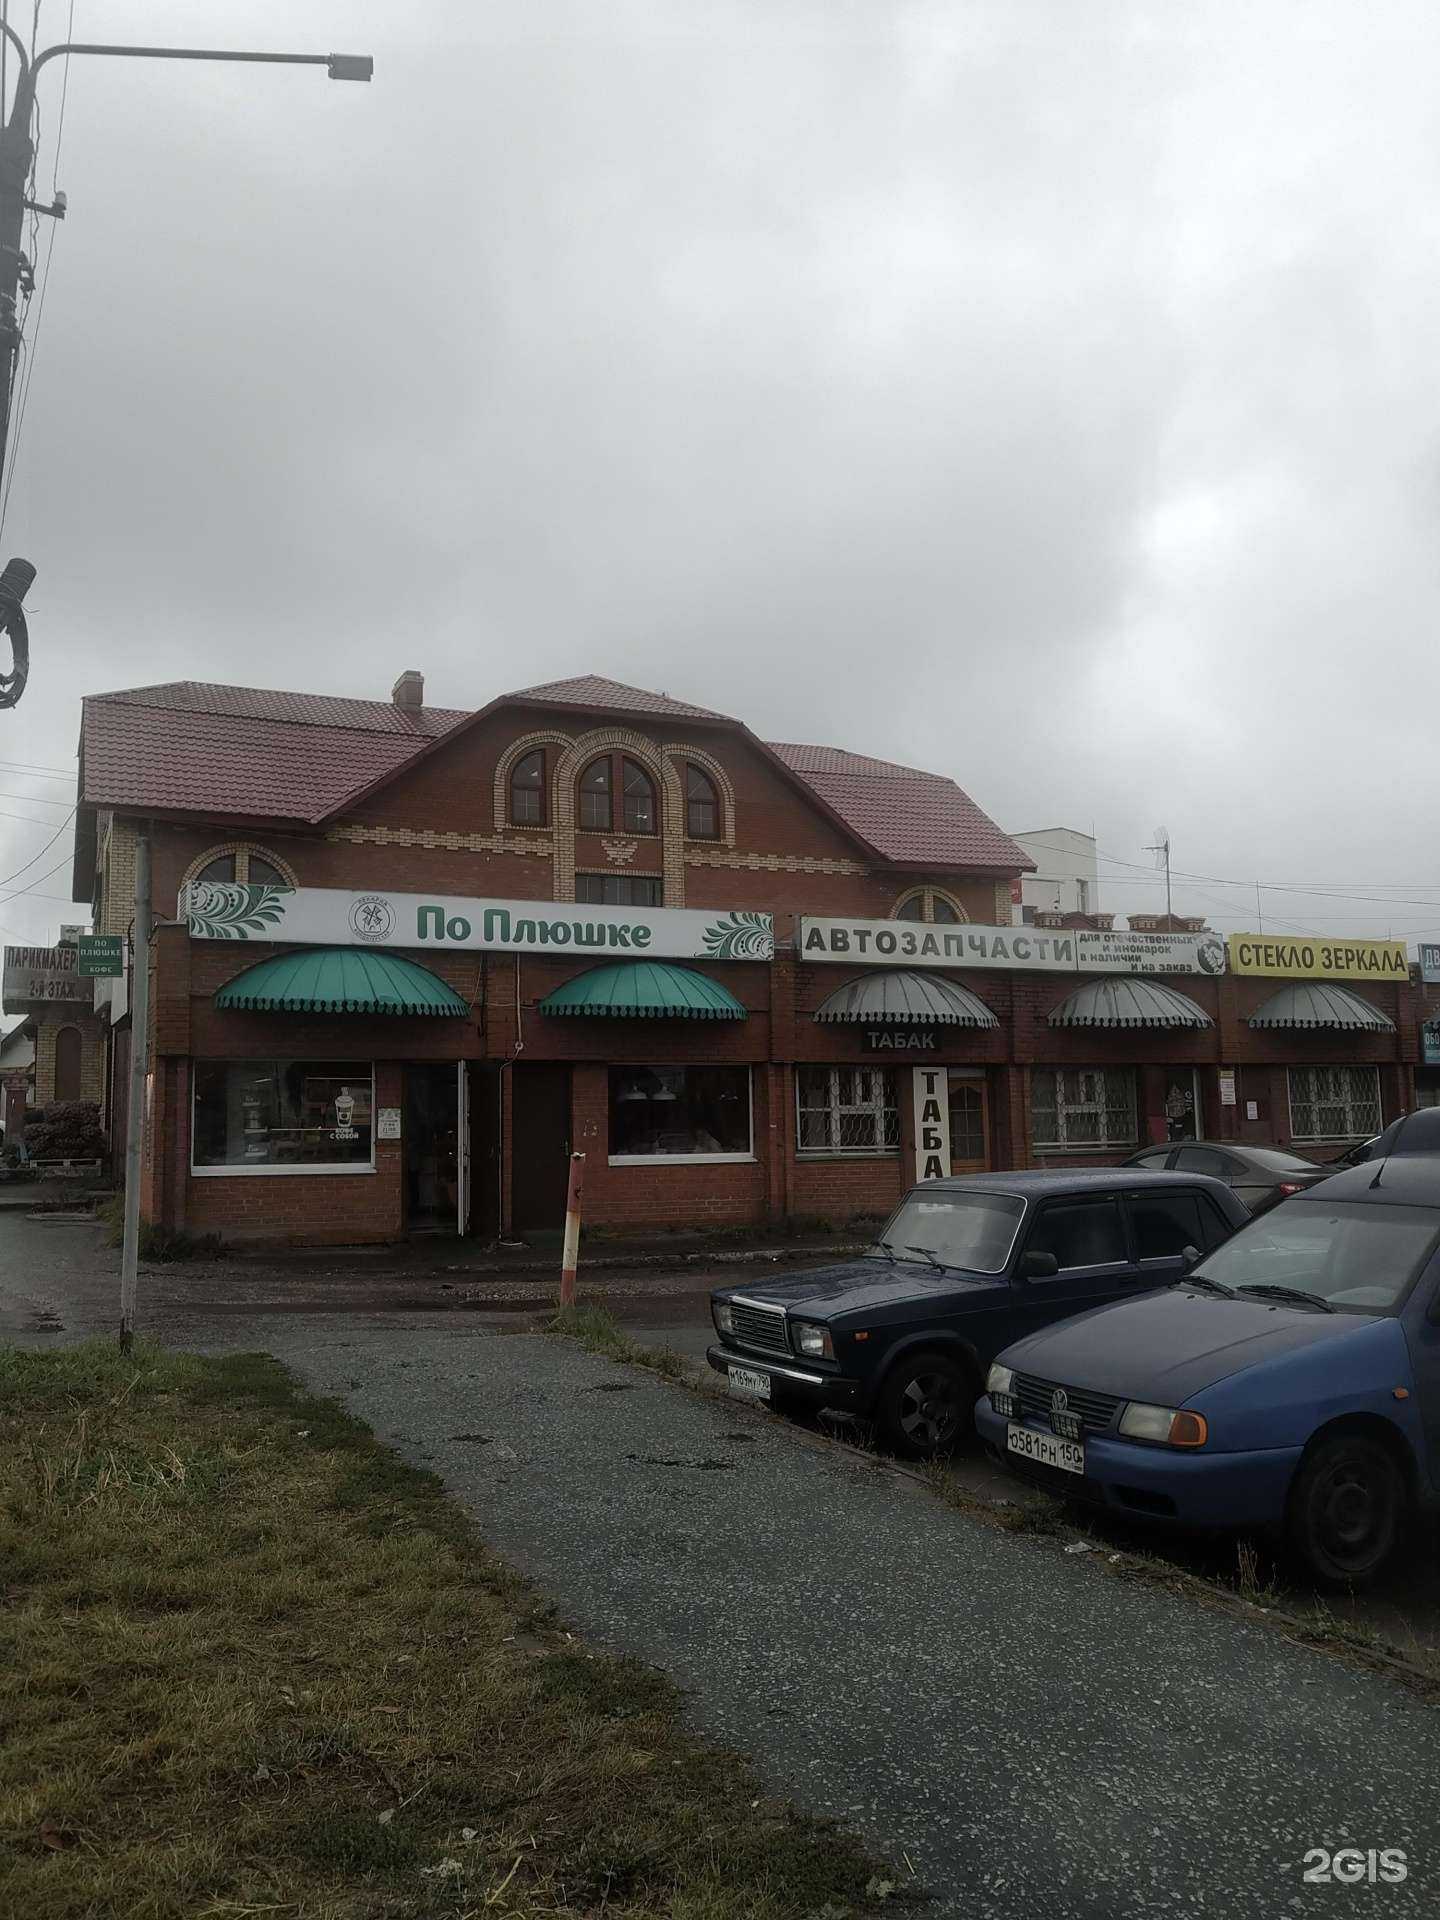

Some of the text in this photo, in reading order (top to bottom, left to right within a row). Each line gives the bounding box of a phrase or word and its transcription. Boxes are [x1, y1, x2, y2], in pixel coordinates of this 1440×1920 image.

[417, 905, 652, 948] По Плюшке
[94, 939, 108, 947] ПО
[804, 927, 1073, 961] АВТОЗАПЧАСТИ
[1114, 944, 1172, 956] иномарок
[7, 948, 80, 971] ПАРИКМАХЕР
[80, 949, 121, 957] ПЛЮШКЕ
[1090, 954, 1142, 963] наличии
[1239, 943, 1407, 972] СТЕКЛО ЗЕРКАЛА
[1141, 962, 1153, 972] на
[1159, 963, 1193, 972] заказ
[867, 1031, 936, 1050] ТАБАК
